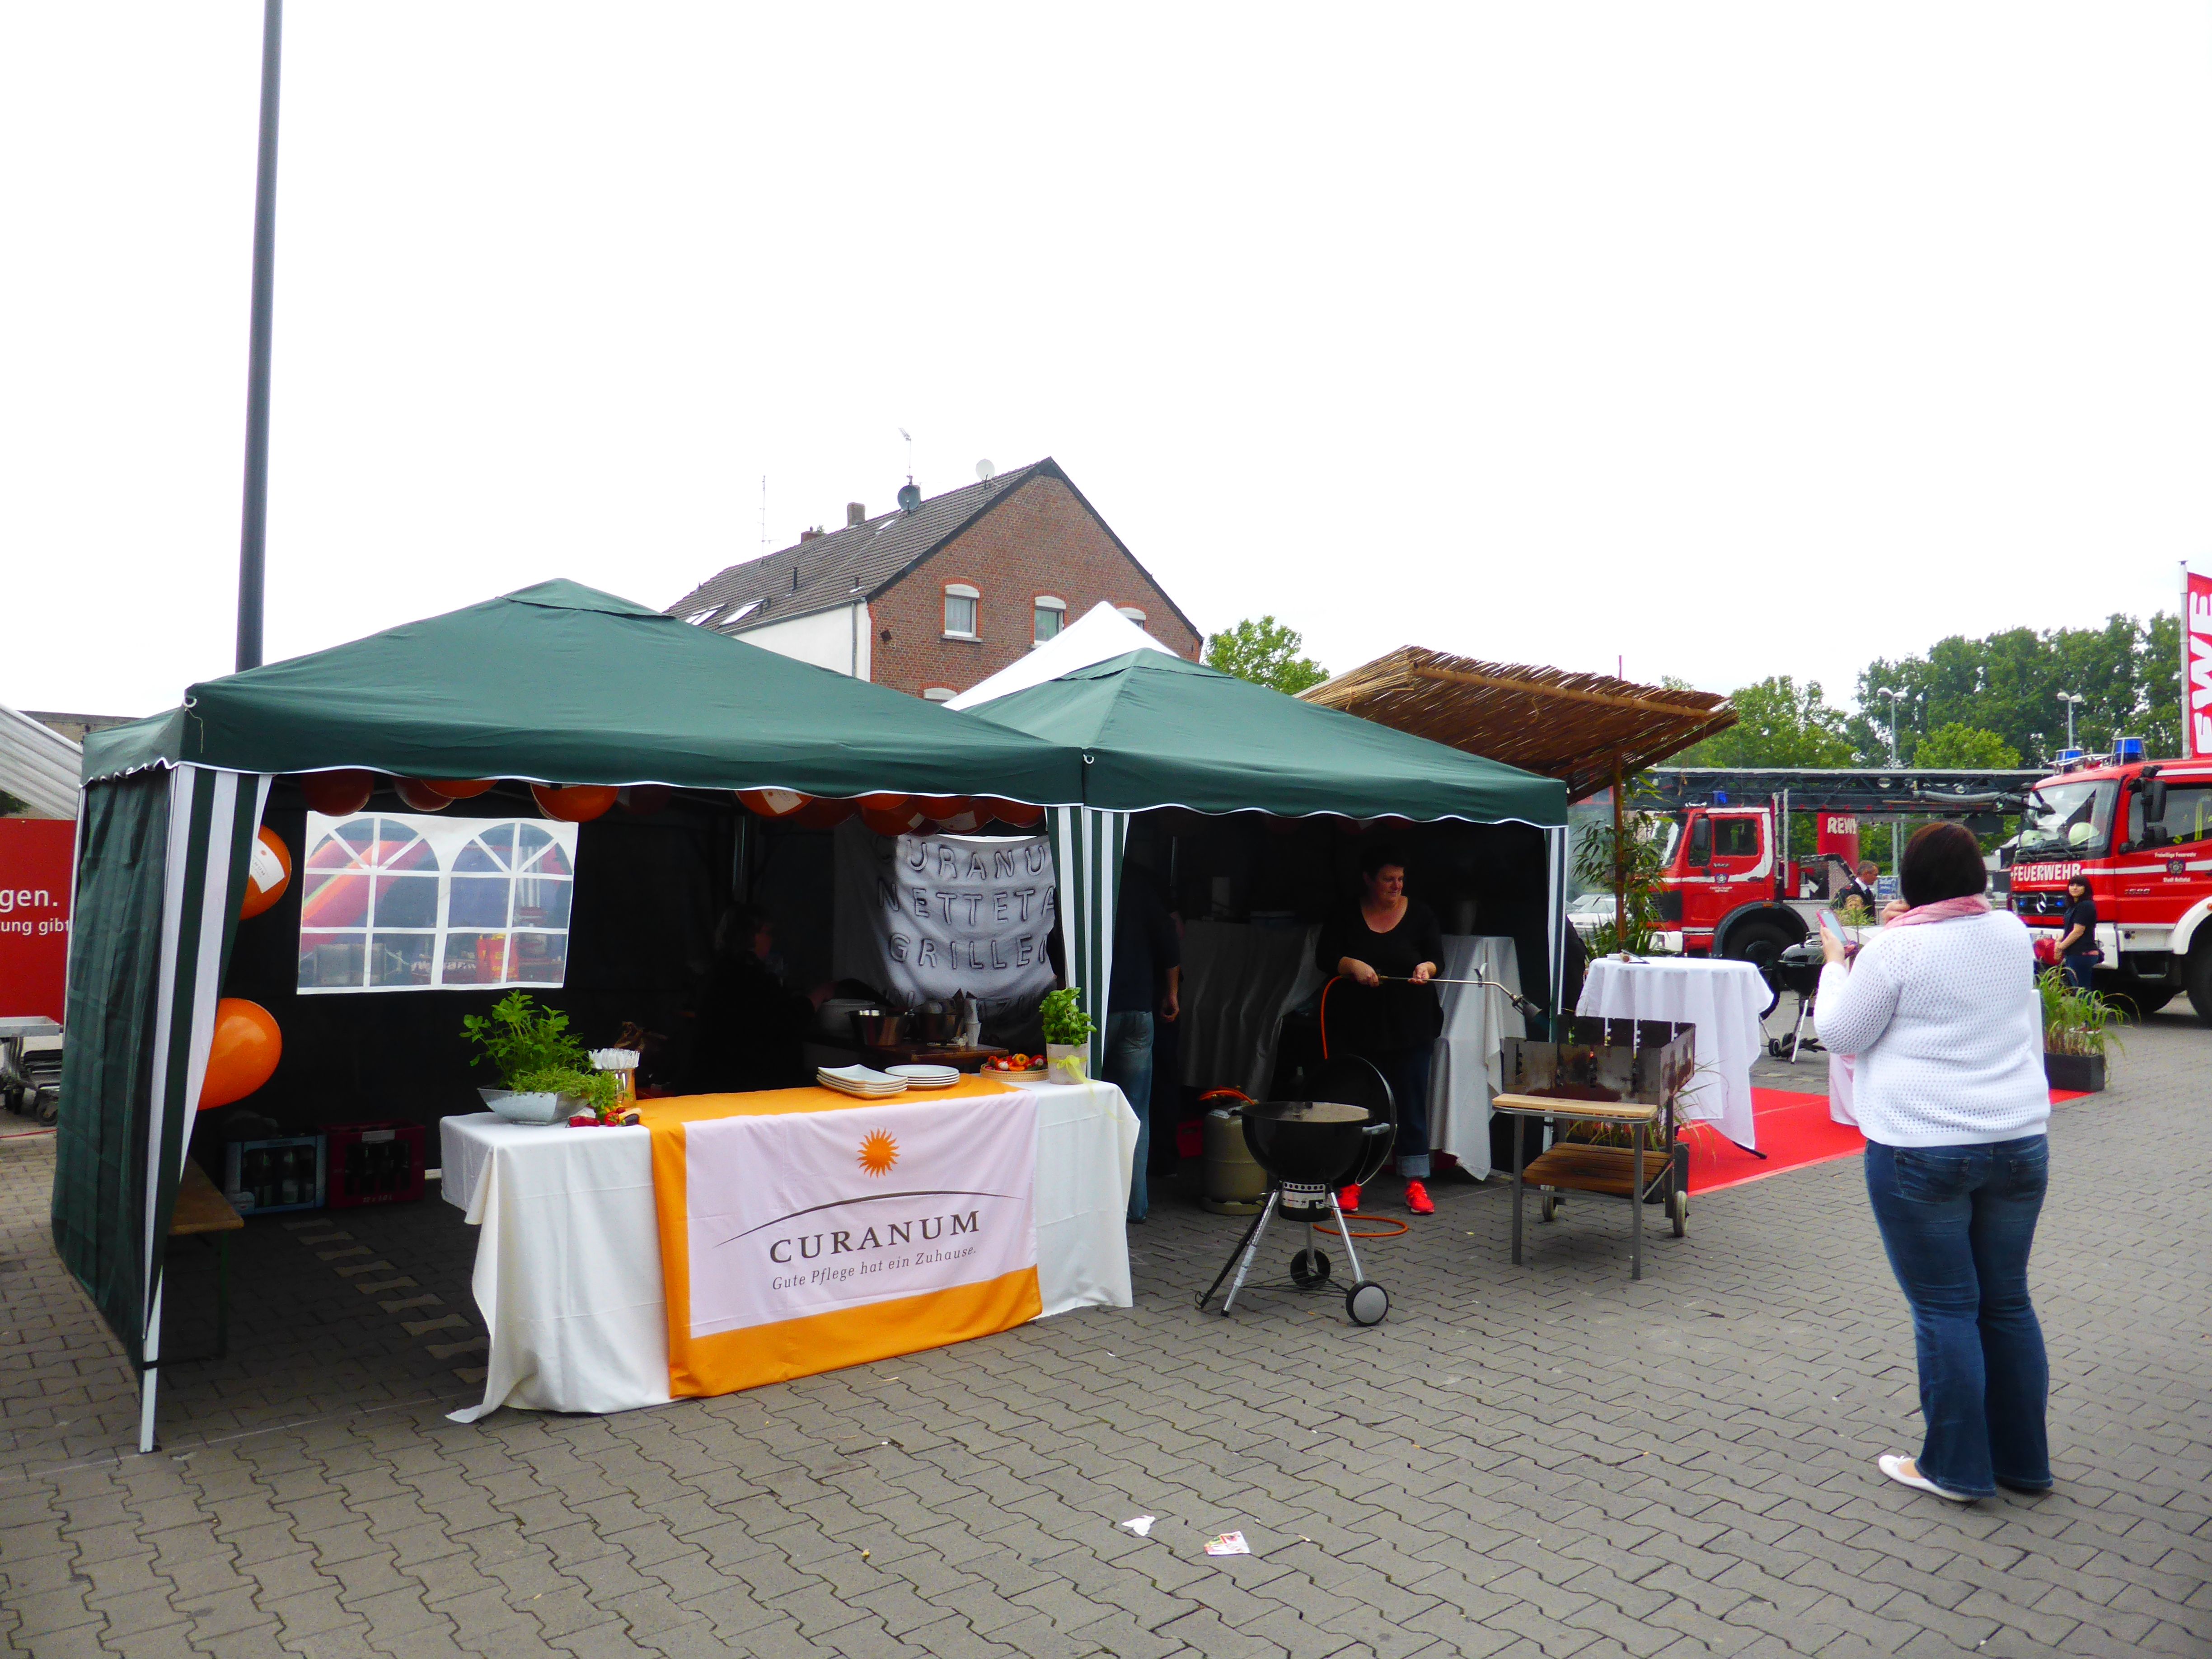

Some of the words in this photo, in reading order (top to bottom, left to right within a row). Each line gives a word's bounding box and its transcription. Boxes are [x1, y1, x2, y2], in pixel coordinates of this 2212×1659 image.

[2189, 591, 2212, 754] EWE
[873, 834, 1046, 881] CURANU
[2013, 863, 2081, 881] FEUERWEHR
[0, 890, 58, 913] gen.
[877, 878, 1055, 926] NETTETA
[0, 921, 32, 935] ung
[770, 1210, 979, 1264] CURANUM
[773, 1275, 806, 1290] Gute
[811, 1267, 855, 1285] Pflege
[860, 1260, 883, 1275] hat
[888, 1256, 909, 1270] ein
[915, 1247, 976, 1265] Zuhause.
